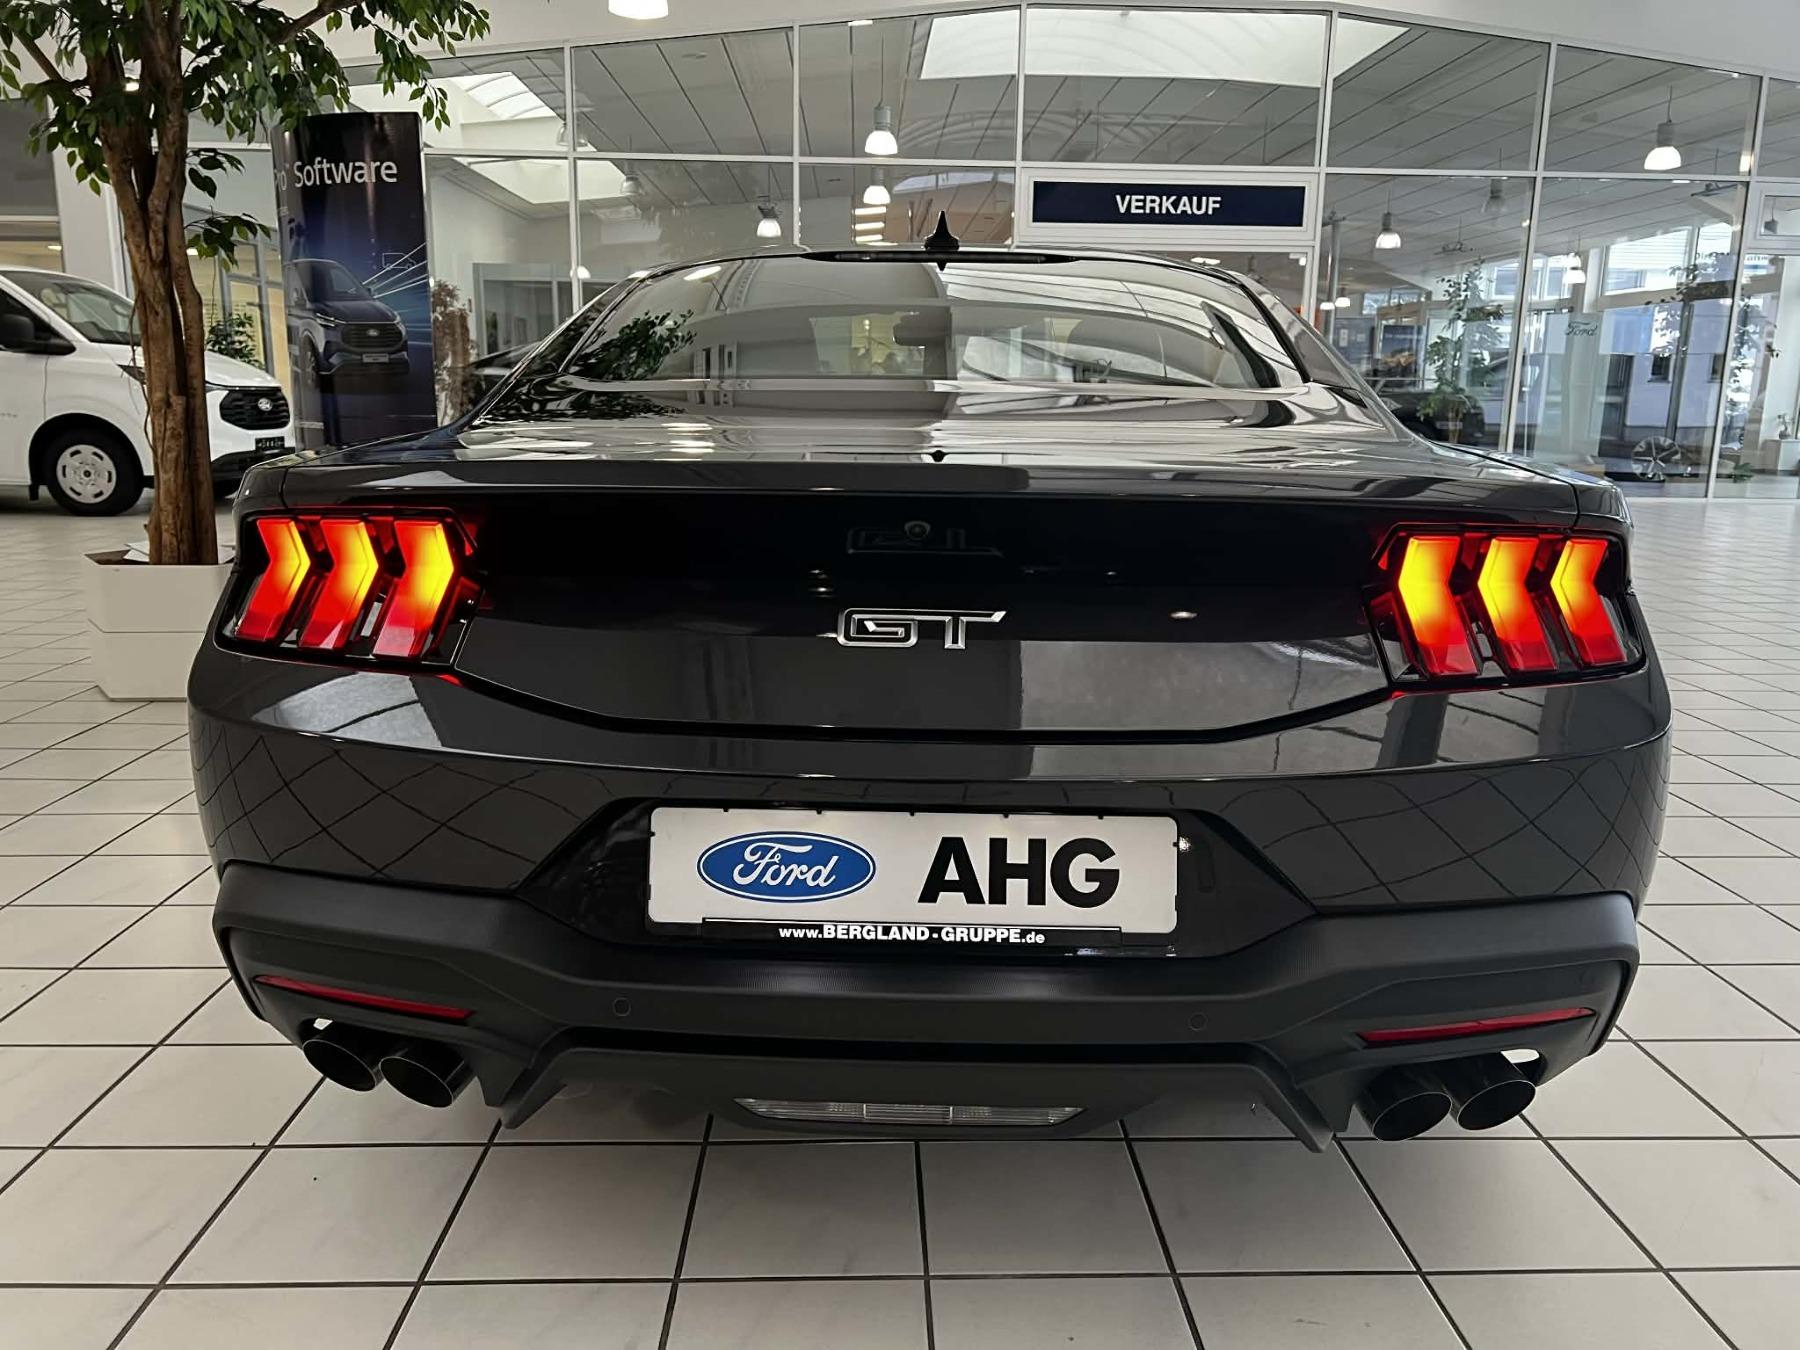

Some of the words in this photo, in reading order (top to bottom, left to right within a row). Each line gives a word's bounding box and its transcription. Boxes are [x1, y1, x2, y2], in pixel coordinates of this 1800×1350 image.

[293, 156, 398, 188] Software
[1115, 194, 1222, 215] VERKAUF
[1565, 320, 1598, 337] Ford
[837, 607, 1007, 650] GT
[732, 841, 839, 888] Ford
[917, 836, 1121, 909] AHG
